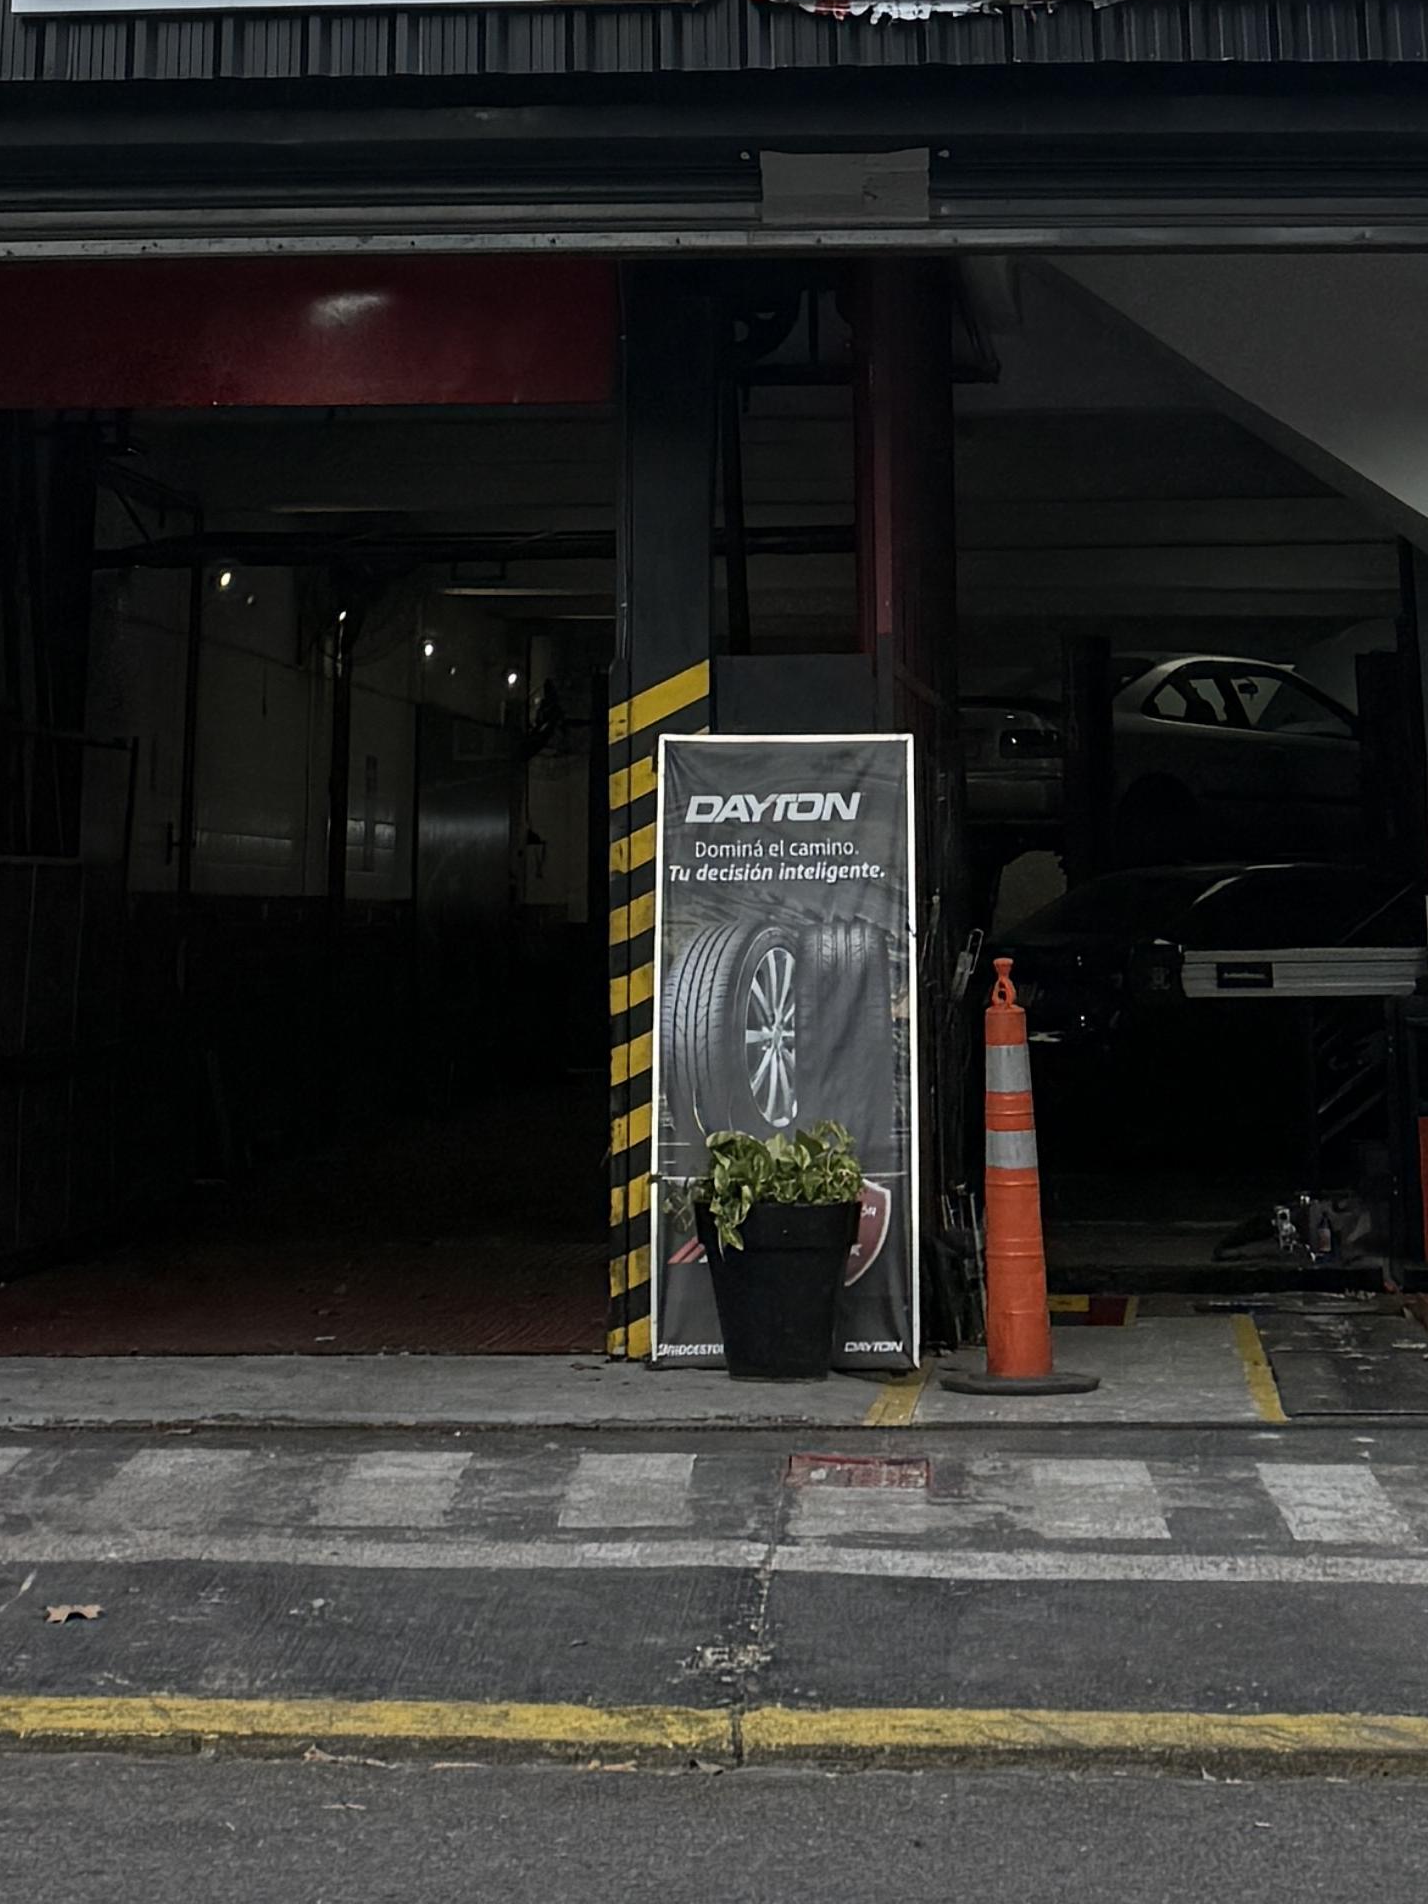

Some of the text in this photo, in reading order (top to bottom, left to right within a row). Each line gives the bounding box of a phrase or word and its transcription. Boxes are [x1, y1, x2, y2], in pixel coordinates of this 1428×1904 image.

[685, 792, 861, 823] DAYTON
[695, 837, 859, 859] Dominá el camino.
[669, 861, 885, 884] Tu decisión inteligente.
[657, 1343, 725, 1357] BRIDGESTO
[843, 1341, 903, 1353] DAYTON
